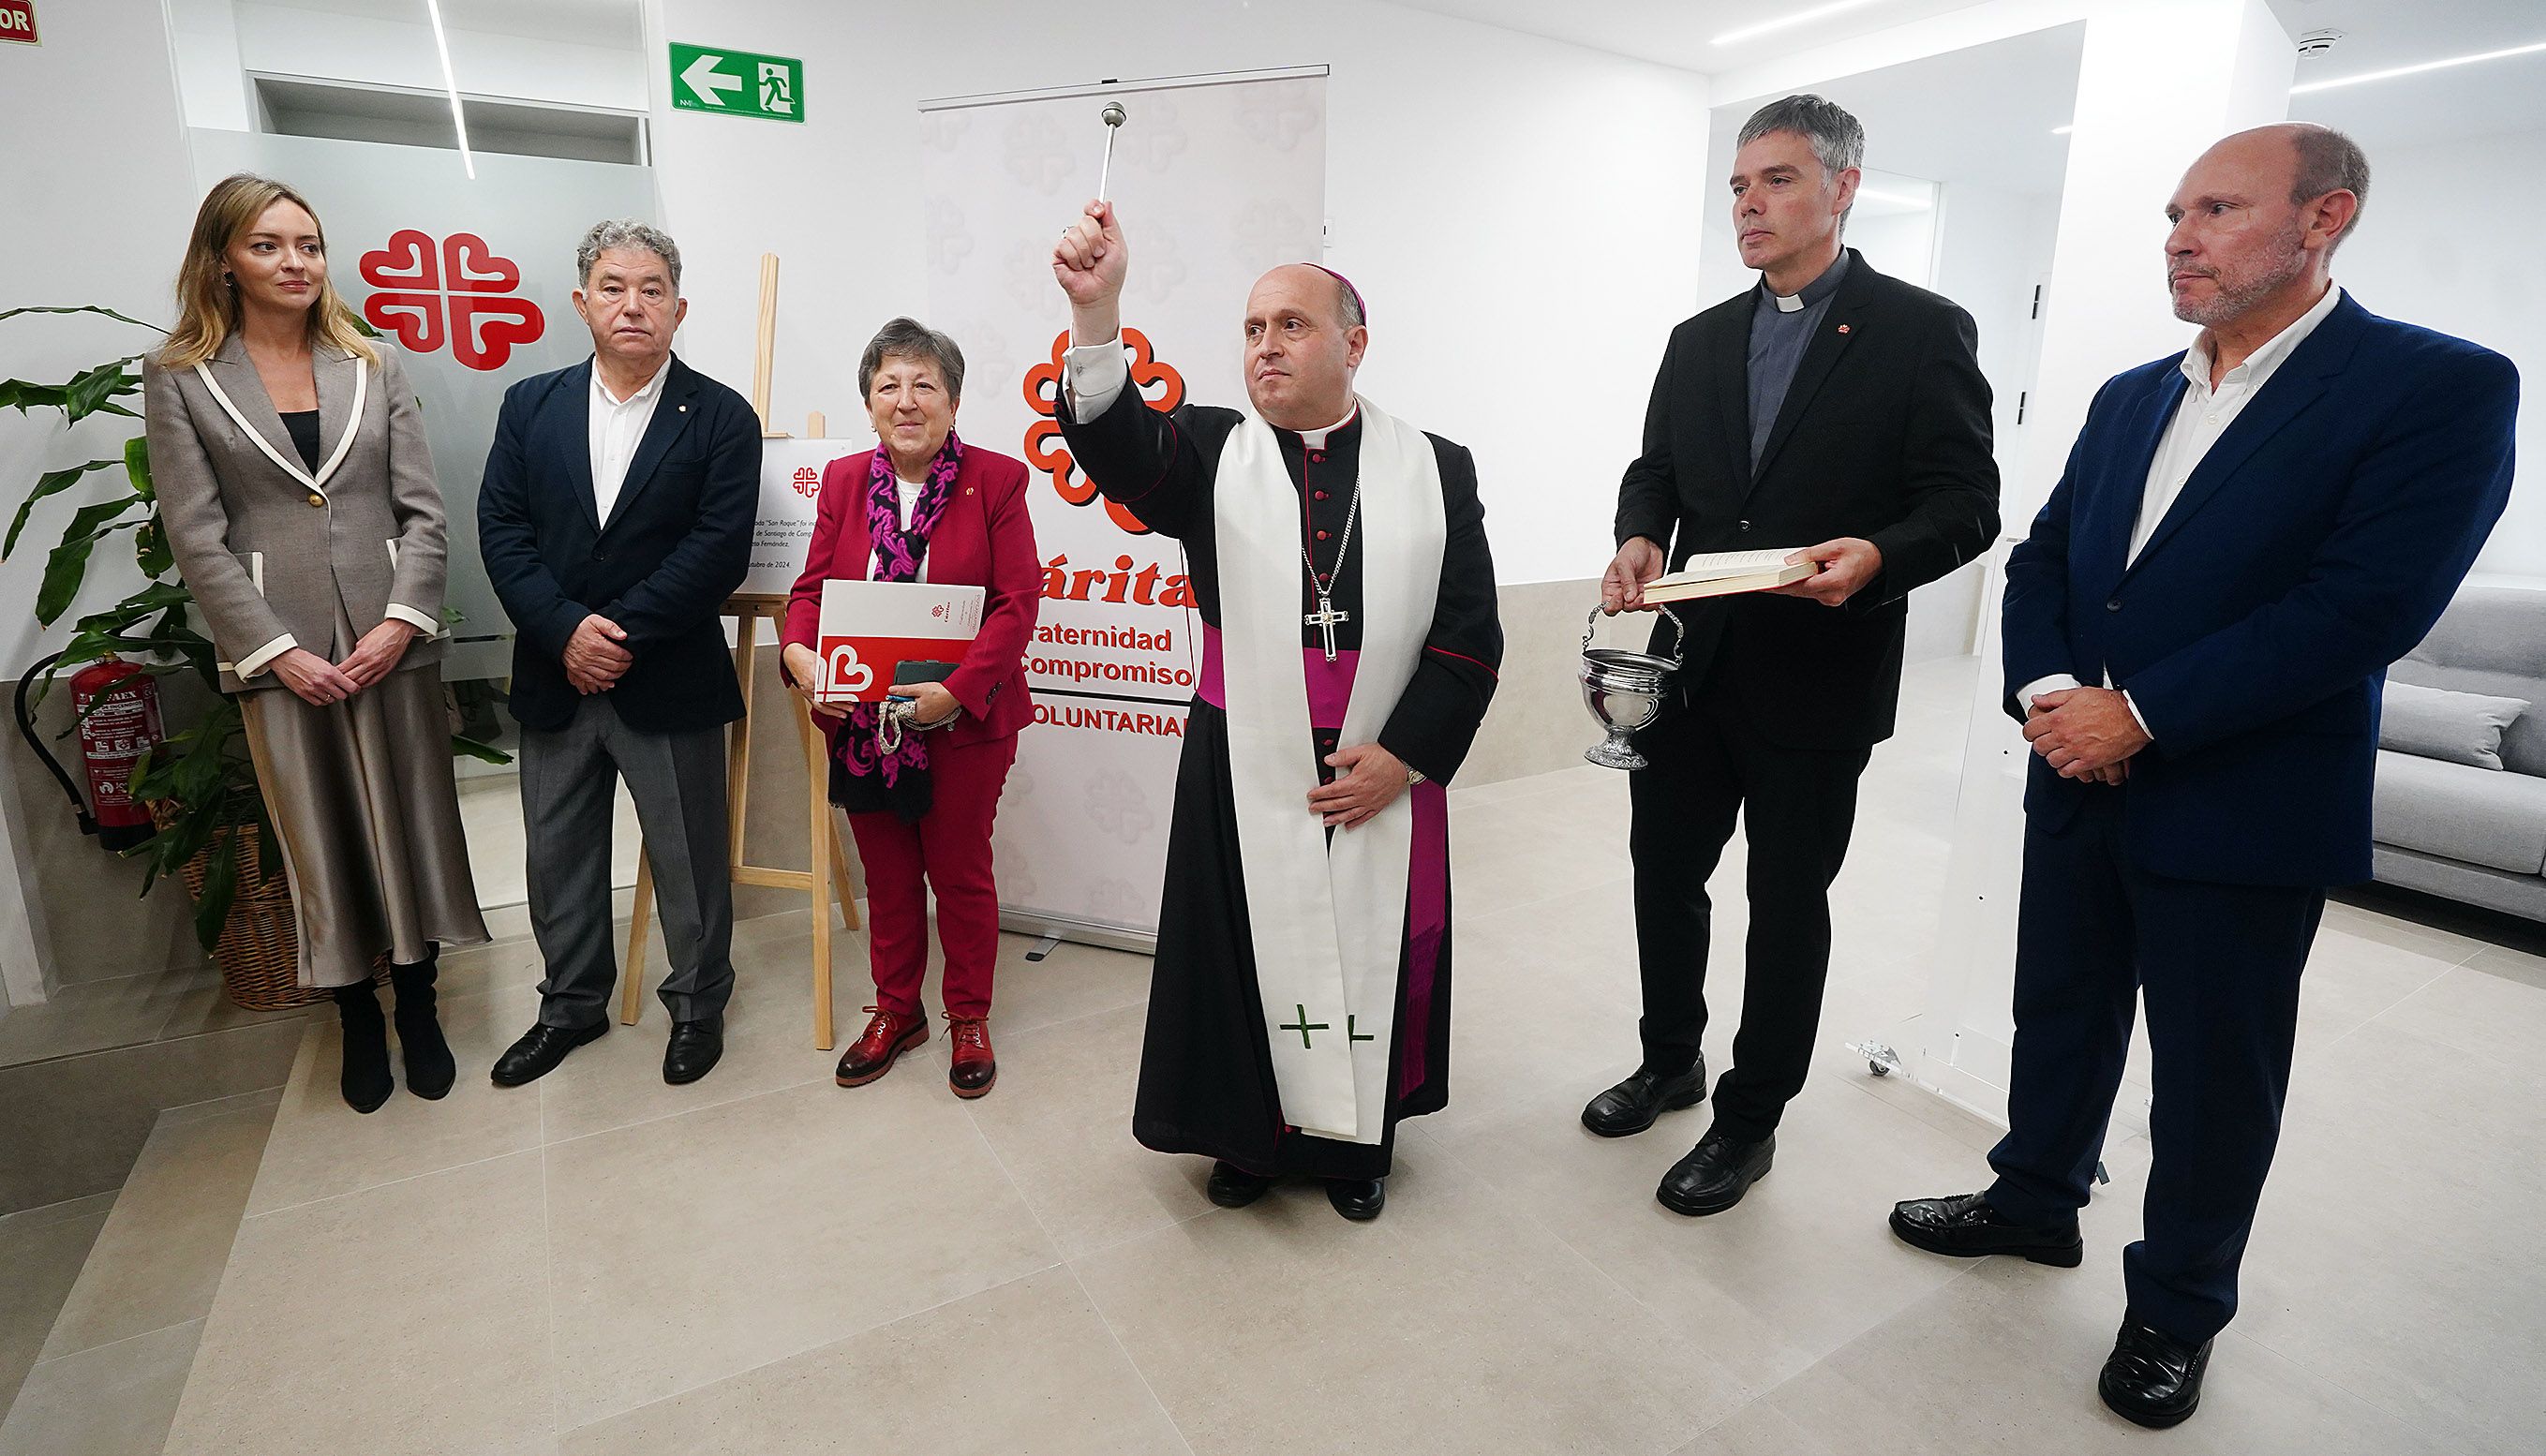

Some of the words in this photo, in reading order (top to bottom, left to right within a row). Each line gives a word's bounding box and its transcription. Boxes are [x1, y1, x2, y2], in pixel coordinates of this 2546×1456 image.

[0, 8, 31, 32] OR
[765, 529, 786, 538] Santiago
[1034, 704, 1189, 738] OLUNTARIA
